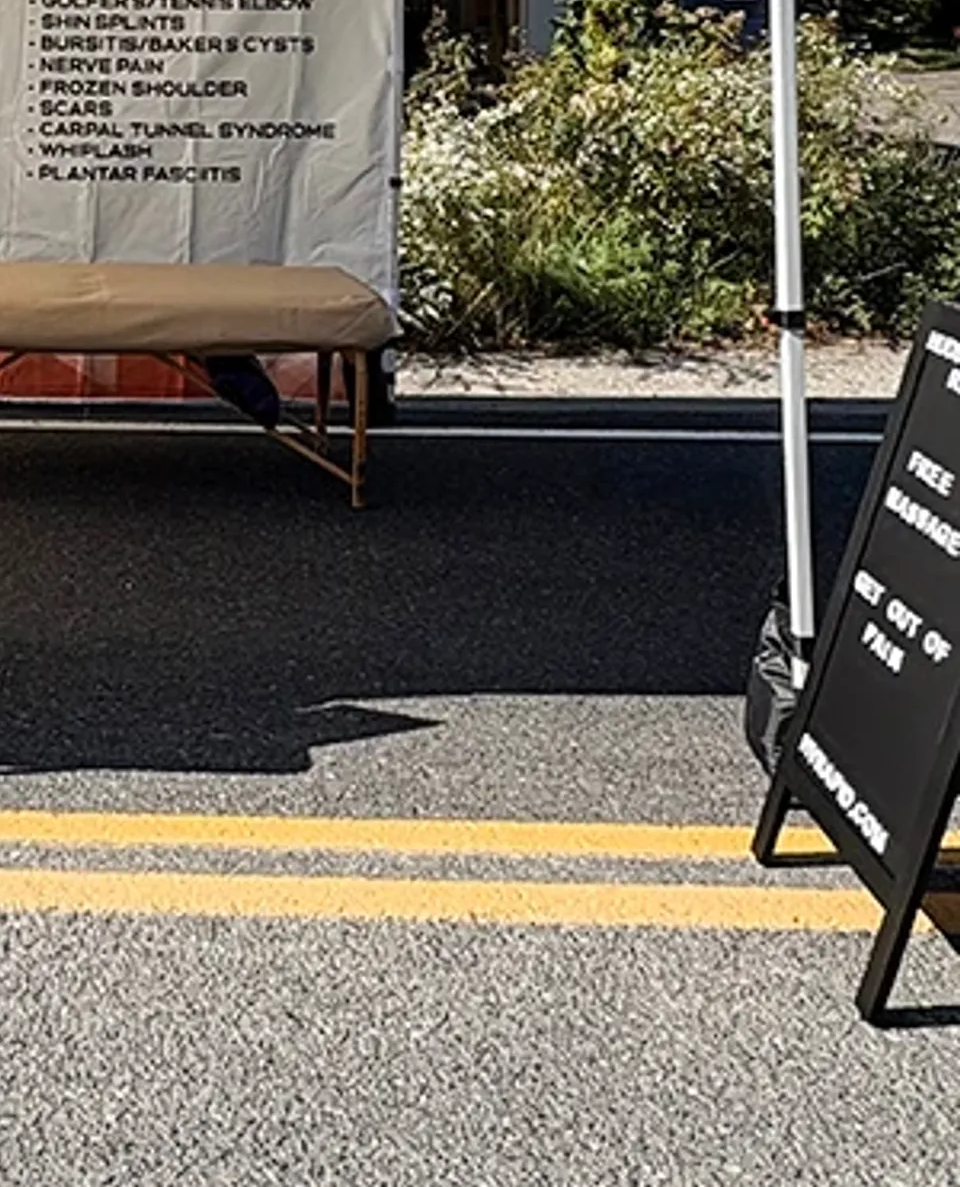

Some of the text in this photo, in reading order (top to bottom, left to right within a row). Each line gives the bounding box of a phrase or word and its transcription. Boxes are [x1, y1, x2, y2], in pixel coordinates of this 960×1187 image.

[41, 15, 185, 31] SHIN SPLINTS
[243, 37, 315, 54] CYSTS
[39, 58, 165, 75] NERVE PAIN
[39, 80, 248, 98] FROZEN SHOULDER
[40, 100, 113, 117] SCARS
[38, 122, 336, 139] CARPAL TUNNEL SYNDROME
[39, 144, 152, 159] WHIPLASH
[38, 165, 137, 182] PLANTAR
[907, 450, 955, 497] FREE
[854, 570, 952, 663] GET OUT OF
